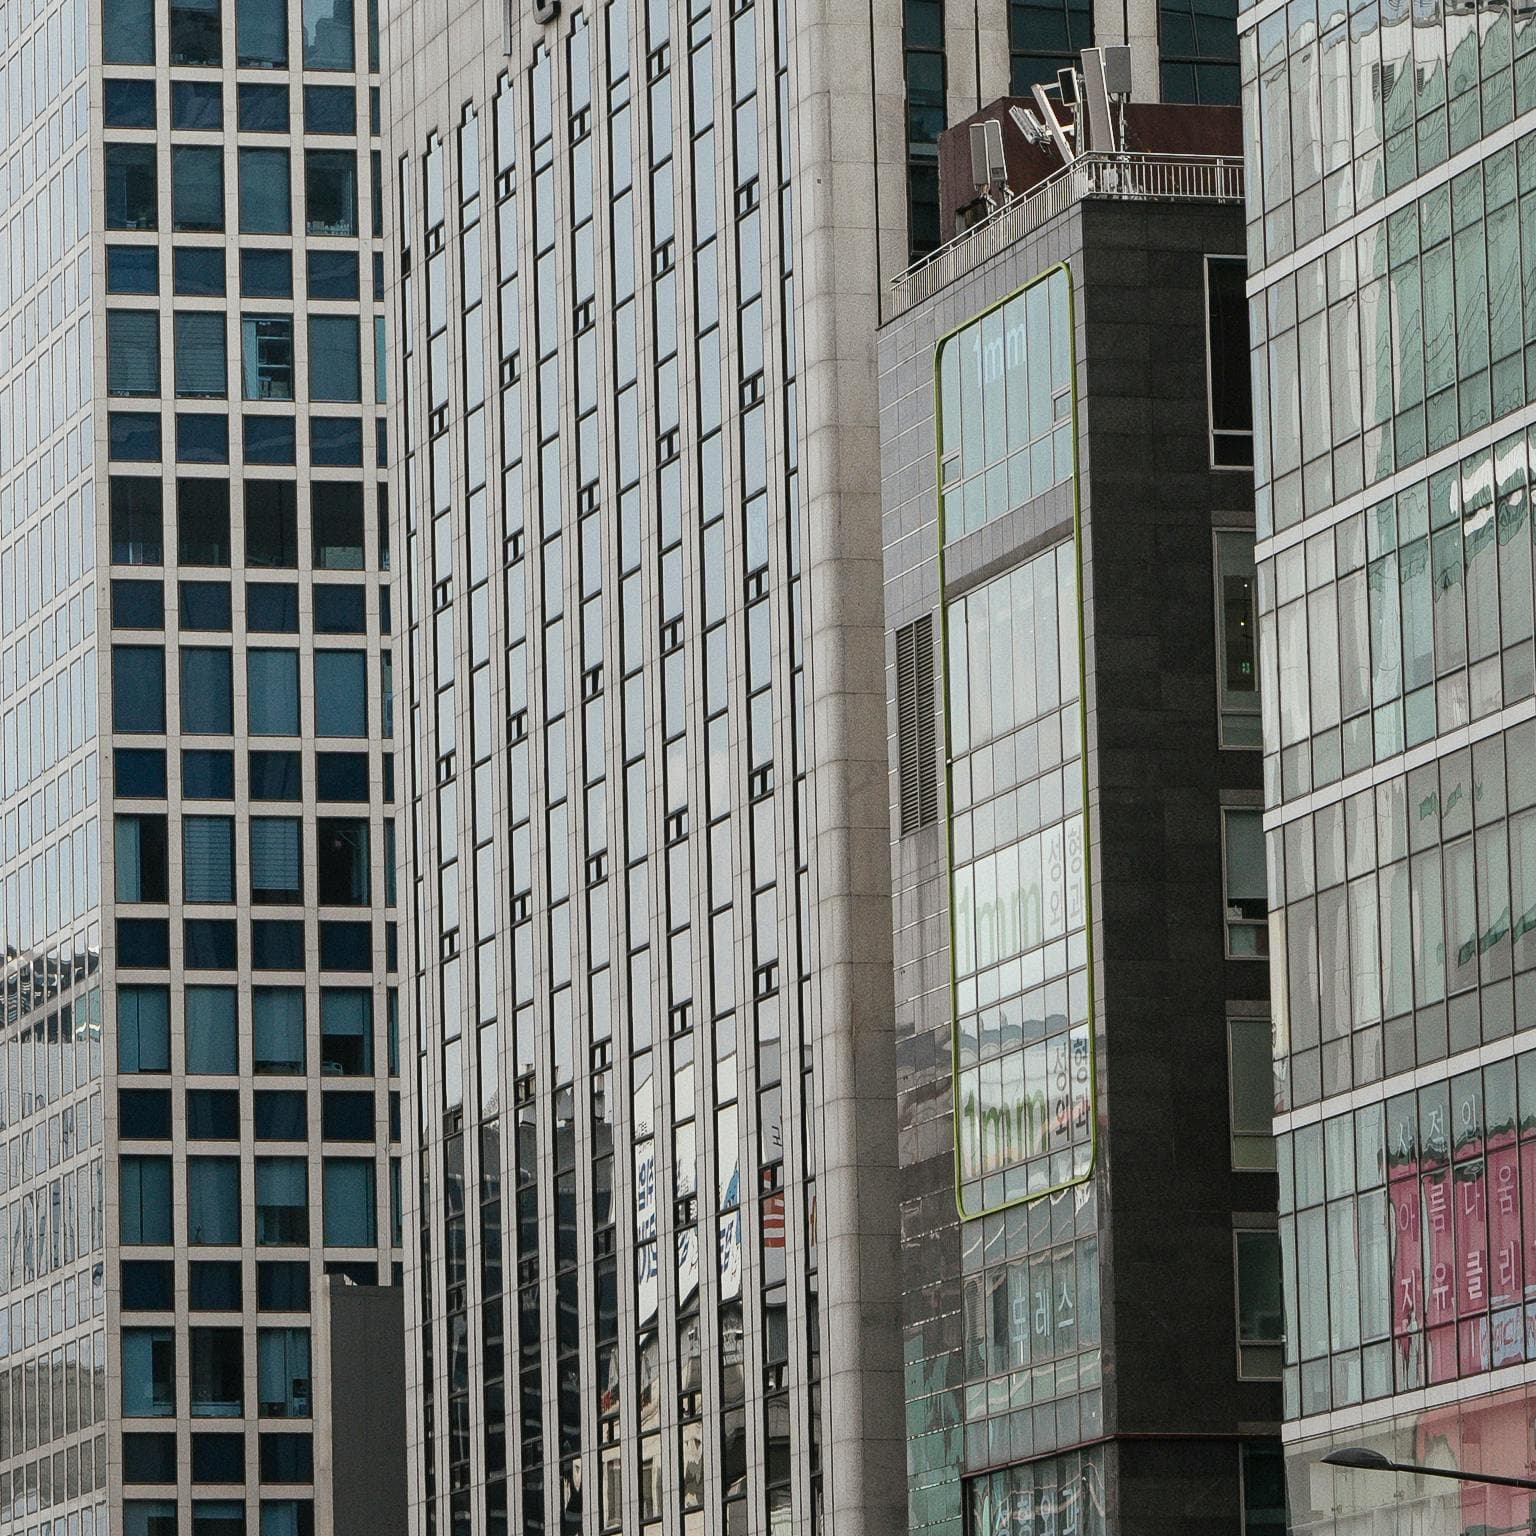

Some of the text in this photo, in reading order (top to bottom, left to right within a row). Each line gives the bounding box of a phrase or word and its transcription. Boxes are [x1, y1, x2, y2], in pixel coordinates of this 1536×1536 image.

[958, 877, 1042, 973] 1mm
[964, 1088, 1046, 1179] 1mm
[1396, 1164, 1515, 1241] 아름다움
[1400, 1239, 1536, 1313] 지유클리
